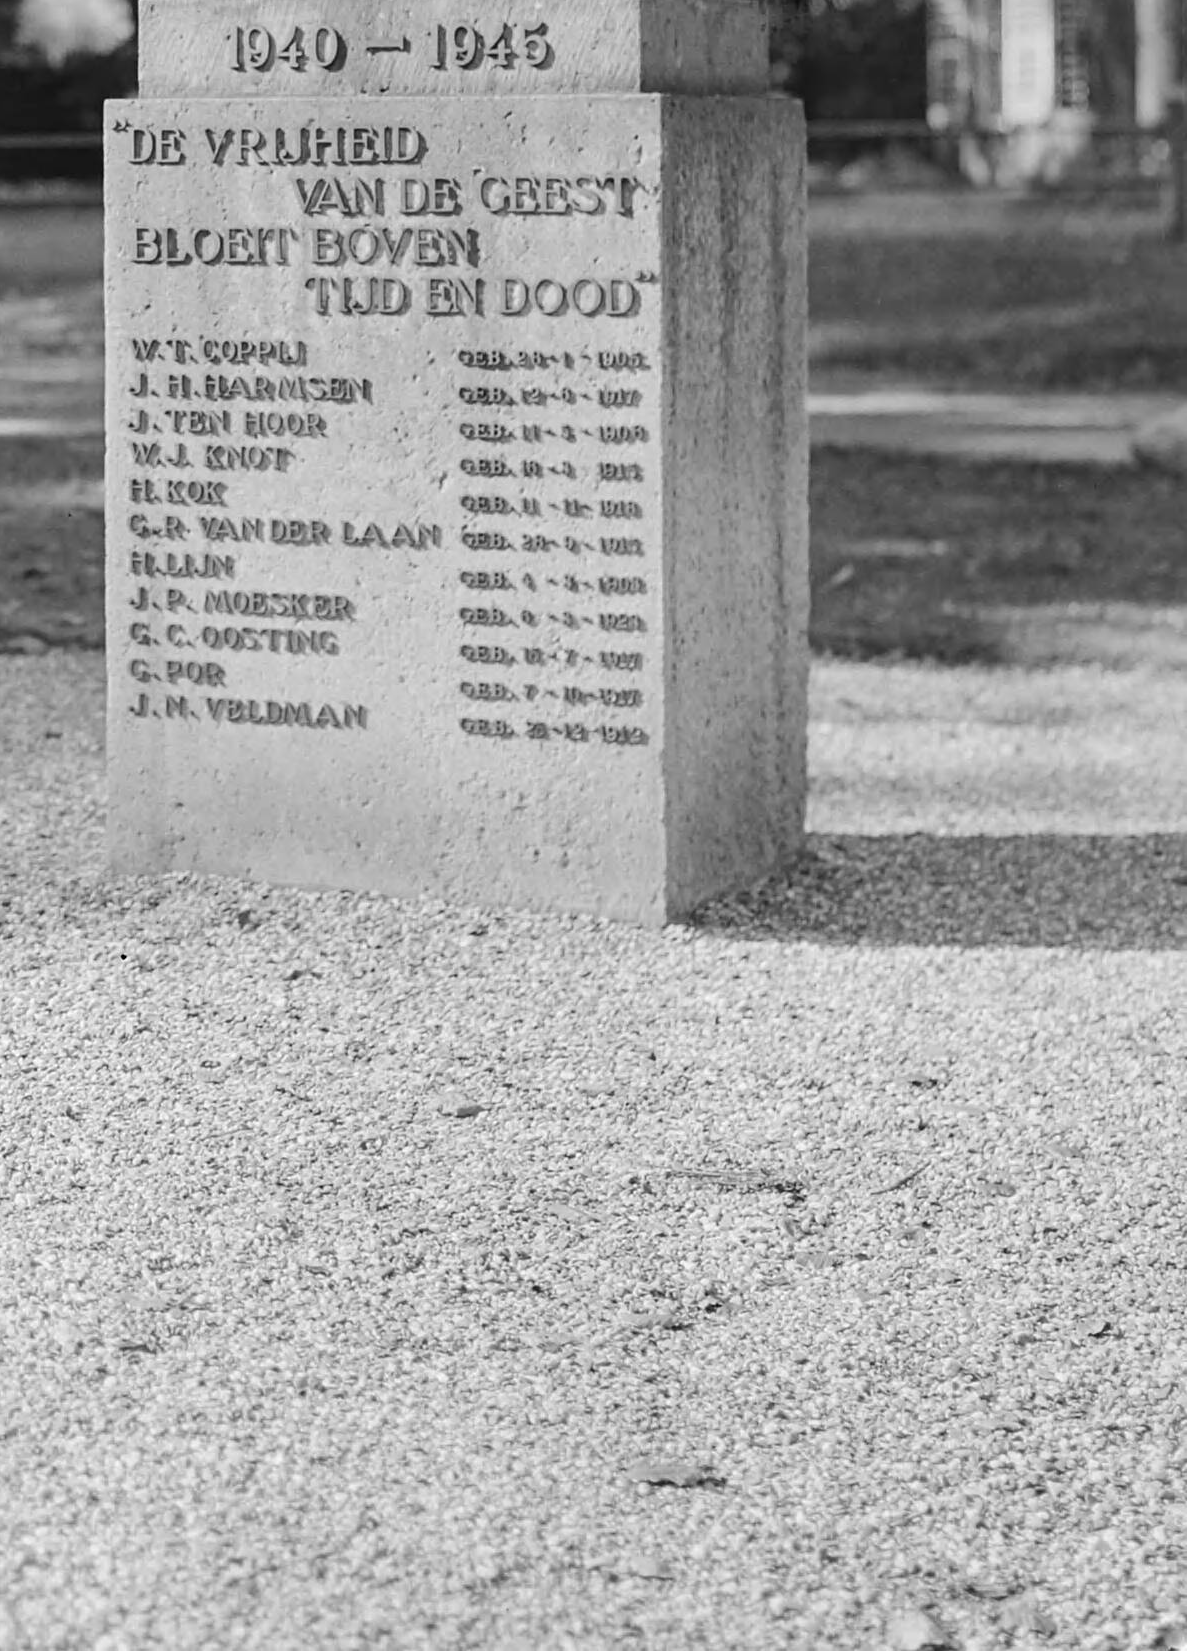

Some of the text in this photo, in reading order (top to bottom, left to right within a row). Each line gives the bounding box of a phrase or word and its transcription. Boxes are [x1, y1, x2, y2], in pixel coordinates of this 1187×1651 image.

[230, 22, 347, 72] 1940
[428, 21, 556, 71] 1945
[205, 126, 428, 167] VRIJHEID
[295, 174, 649, 218] VAN DE GEEST
[131, 227, 480, 268] BLOEIT BOVEN
[305, 277, 412, 317] TIJD
[428, 278, 485, 315] EN
[165, 410, 231, 437] TEN
[244, 411, 328, 438] HOOR
[206, 445, 296, 472] KNOT
[167, 480, 229, 507] KOK
[198, 516, 263, 544] VAN
[270, 519, 333, 548] DER
[341, 521, 443, 549] LAAN
[204, 590, 357, 623] MOESKER
[202, 625, 340, 655] OOSTING
[166, 660, 227, 687] POR
[205, 697, 368, 729] VELDMAN
